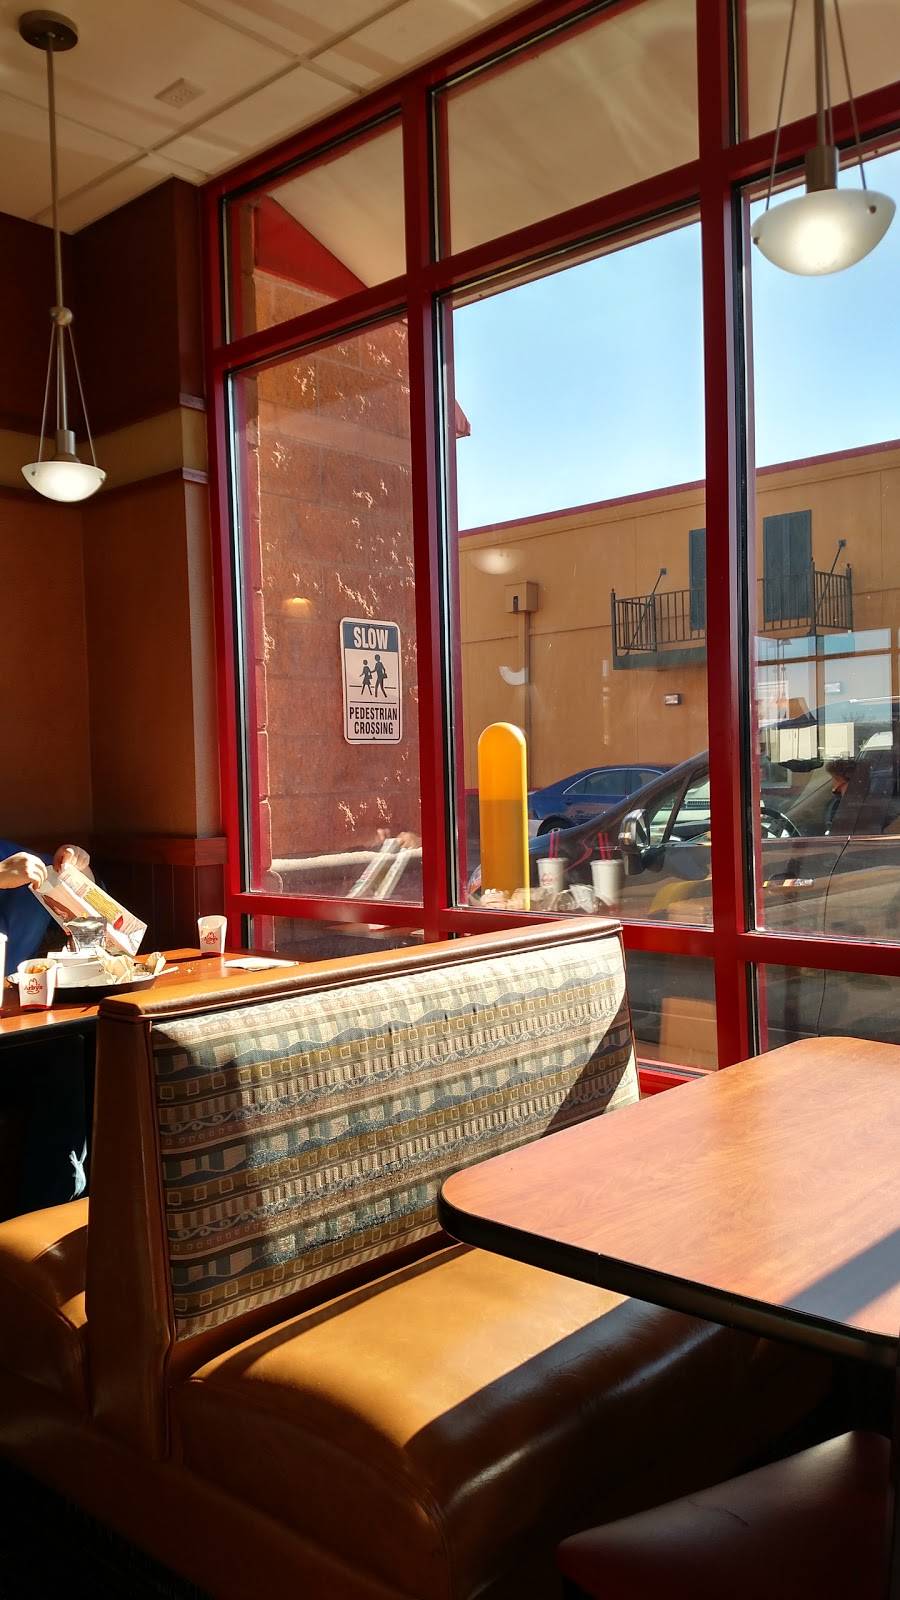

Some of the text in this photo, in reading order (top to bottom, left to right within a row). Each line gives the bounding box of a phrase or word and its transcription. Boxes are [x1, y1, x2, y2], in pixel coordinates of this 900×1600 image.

[353, 627, 389, 649] SLOW
[349, 706, 398, 721] PEDESTRIAN
[354, 721, 394, 735] CROSSING
